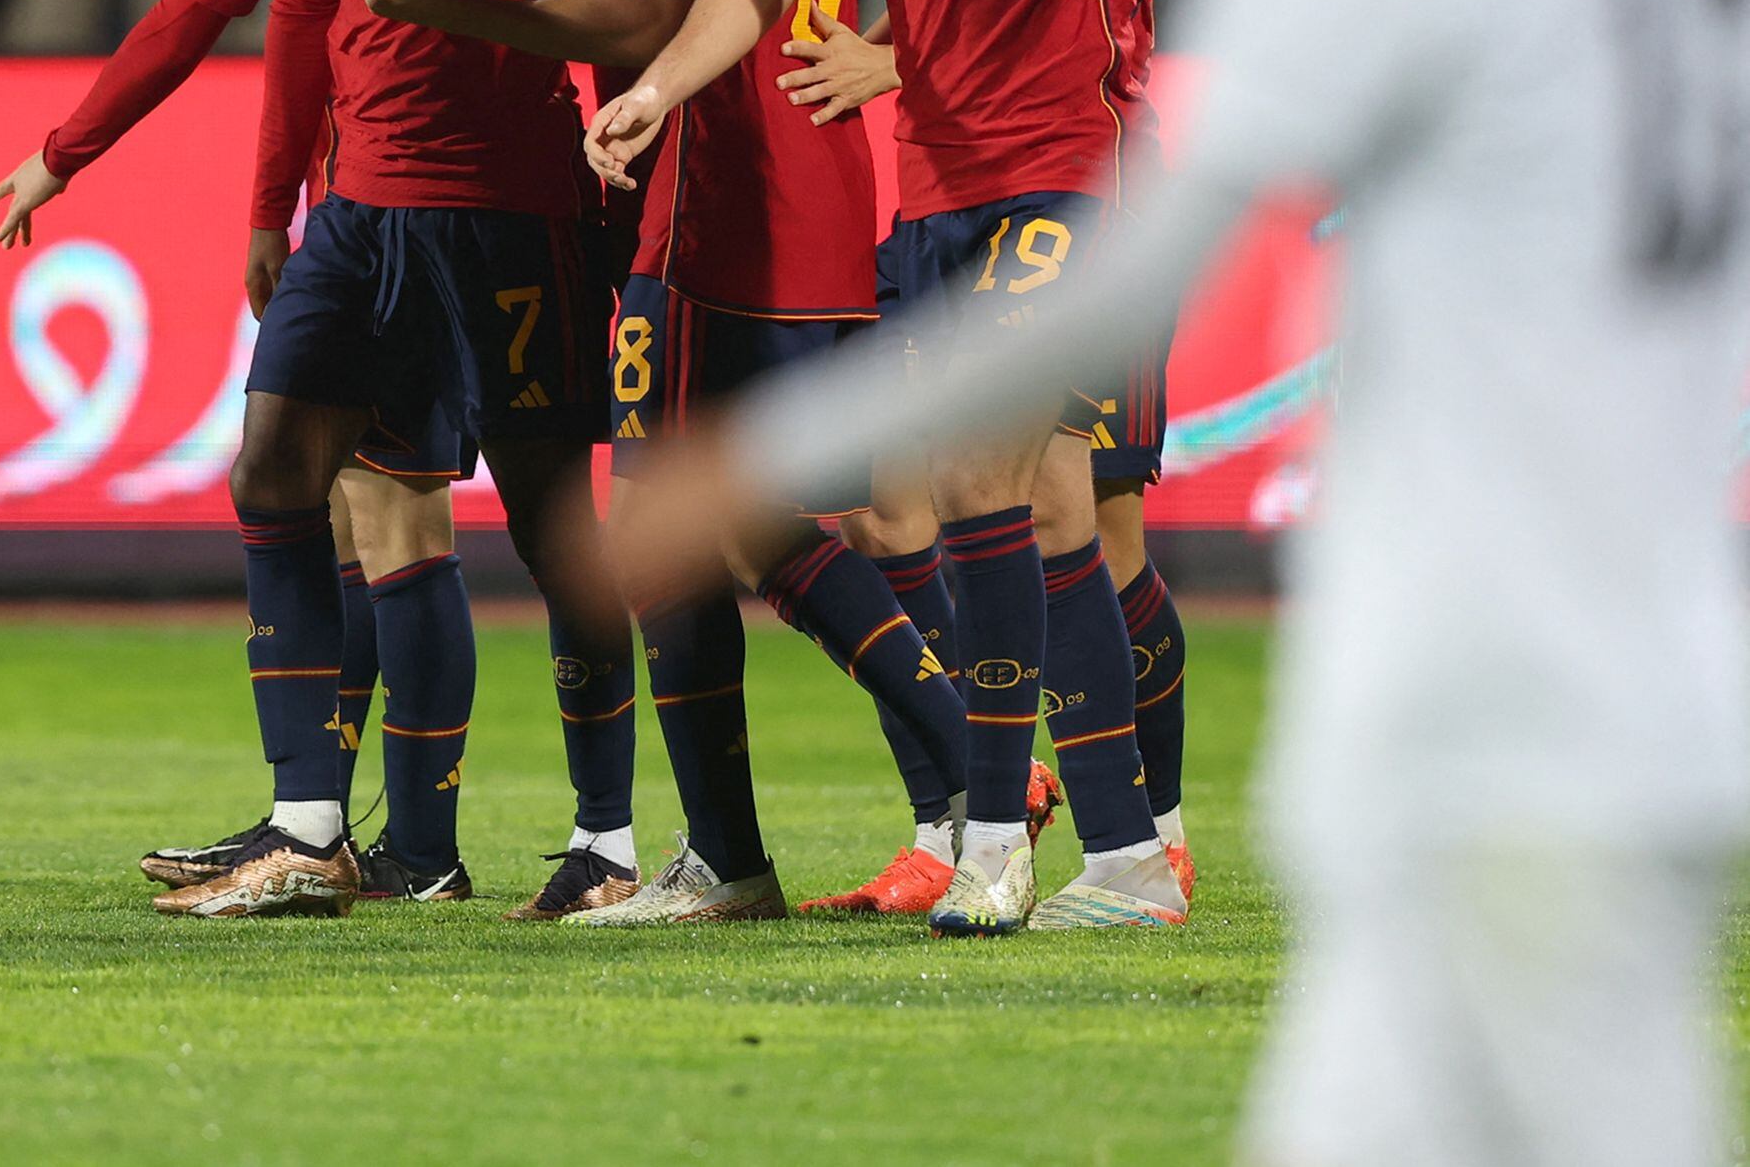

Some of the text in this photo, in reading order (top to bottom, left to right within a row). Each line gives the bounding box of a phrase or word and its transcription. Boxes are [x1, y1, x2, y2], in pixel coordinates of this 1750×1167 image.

[973, 216, 1073, 296] 19
[496, 286, 542, 374] 7
[613, 315, 652, 403] 8
[1066, 692, 1086, 705] 09
